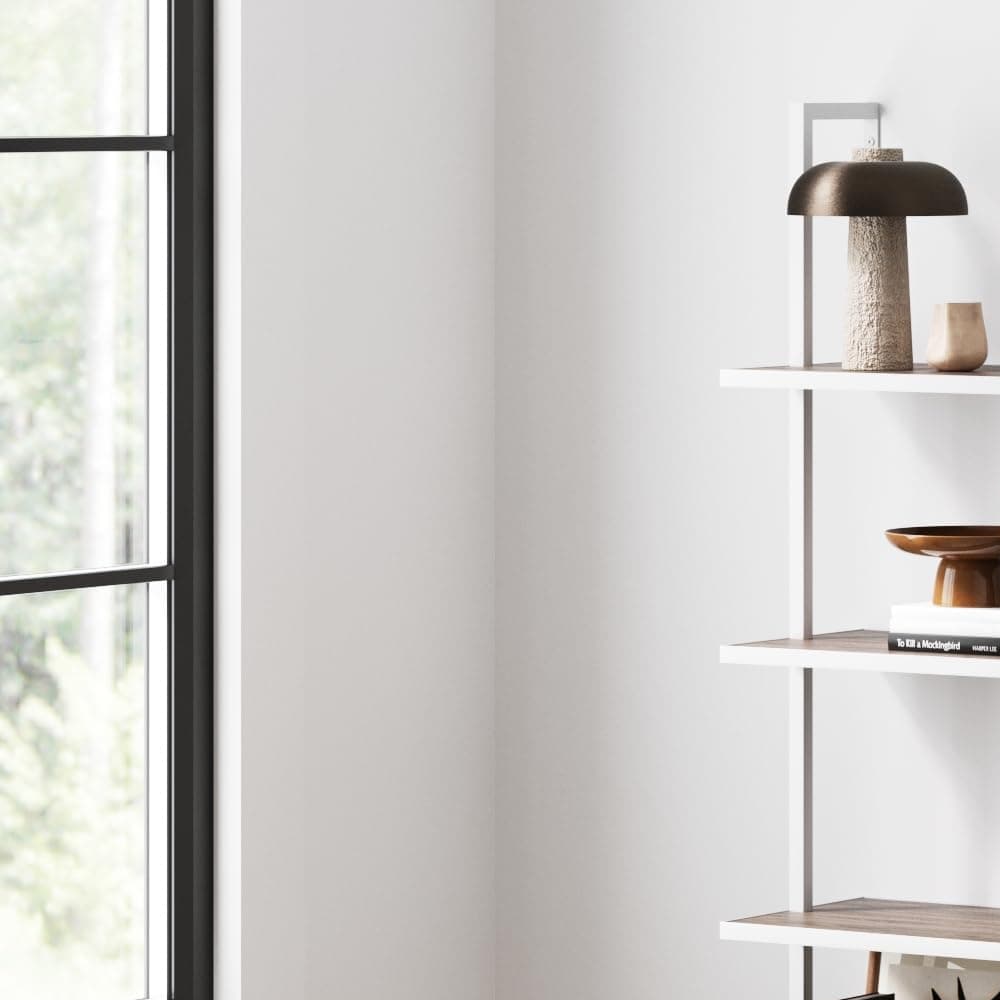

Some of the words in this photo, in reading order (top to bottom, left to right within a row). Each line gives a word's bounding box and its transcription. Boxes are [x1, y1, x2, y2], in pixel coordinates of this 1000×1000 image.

[897, 638, 905, 648] To
[917, 641, 921, 649] a
[922, 639, 961, 652] Mockingbird
